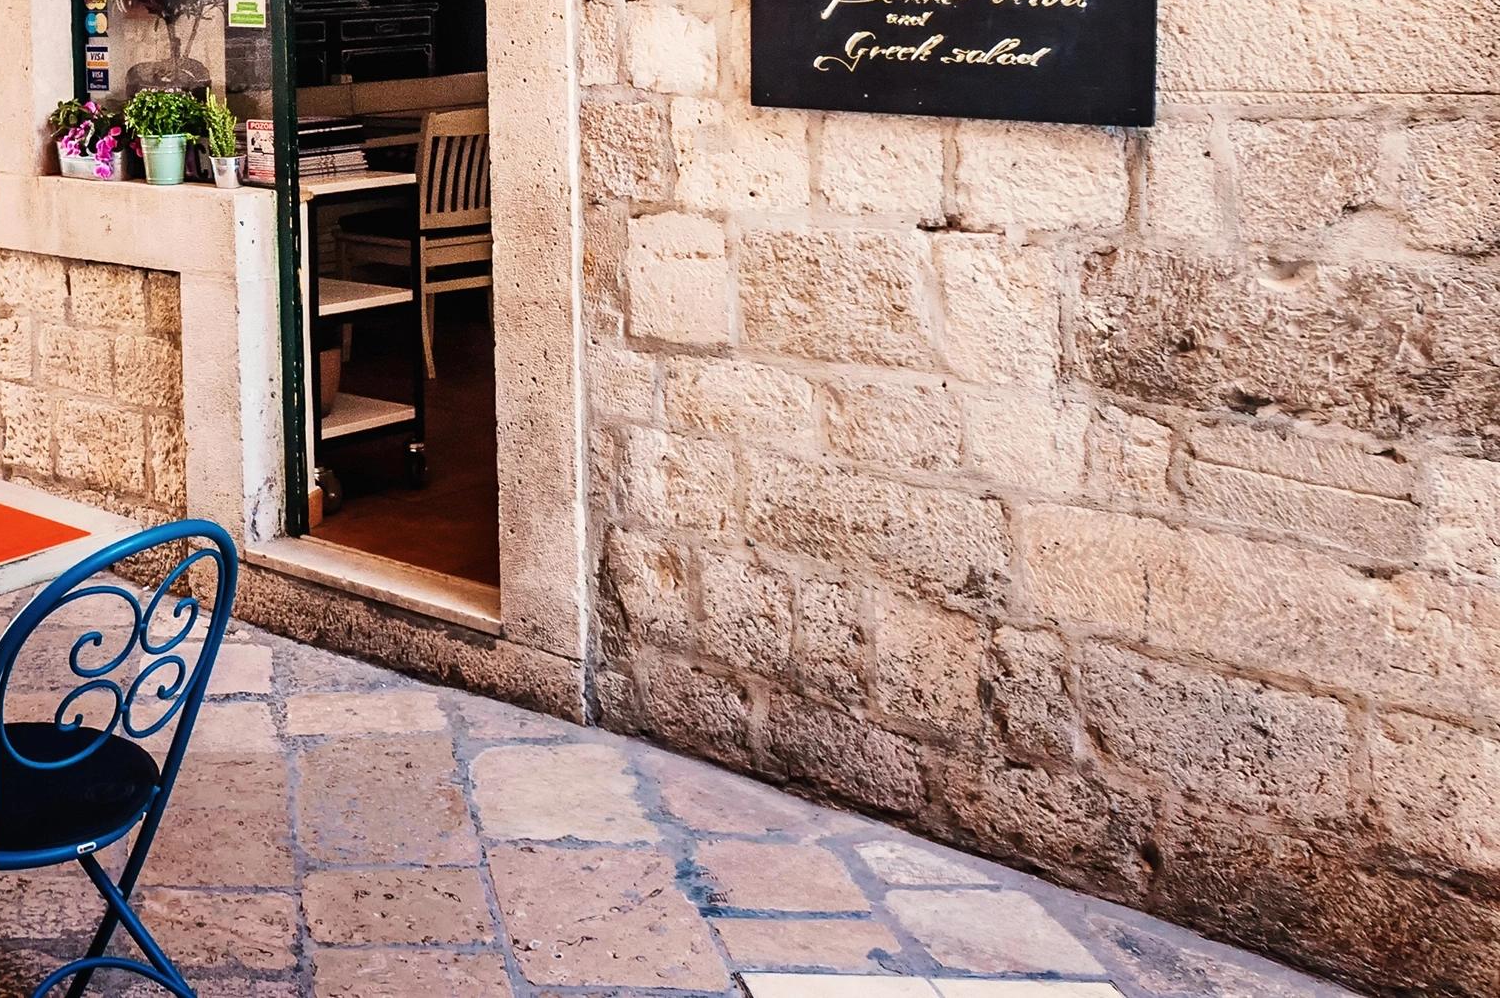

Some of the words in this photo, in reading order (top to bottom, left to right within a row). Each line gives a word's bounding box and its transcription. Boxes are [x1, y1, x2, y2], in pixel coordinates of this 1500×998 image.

[885, 10, 934, 27] and
[90, 52, 105, 61] VISA
[812, 30, 944, 73] Greek
[940, 37, 1052, 67] salad
[91, 71, 104, 79] VISA
